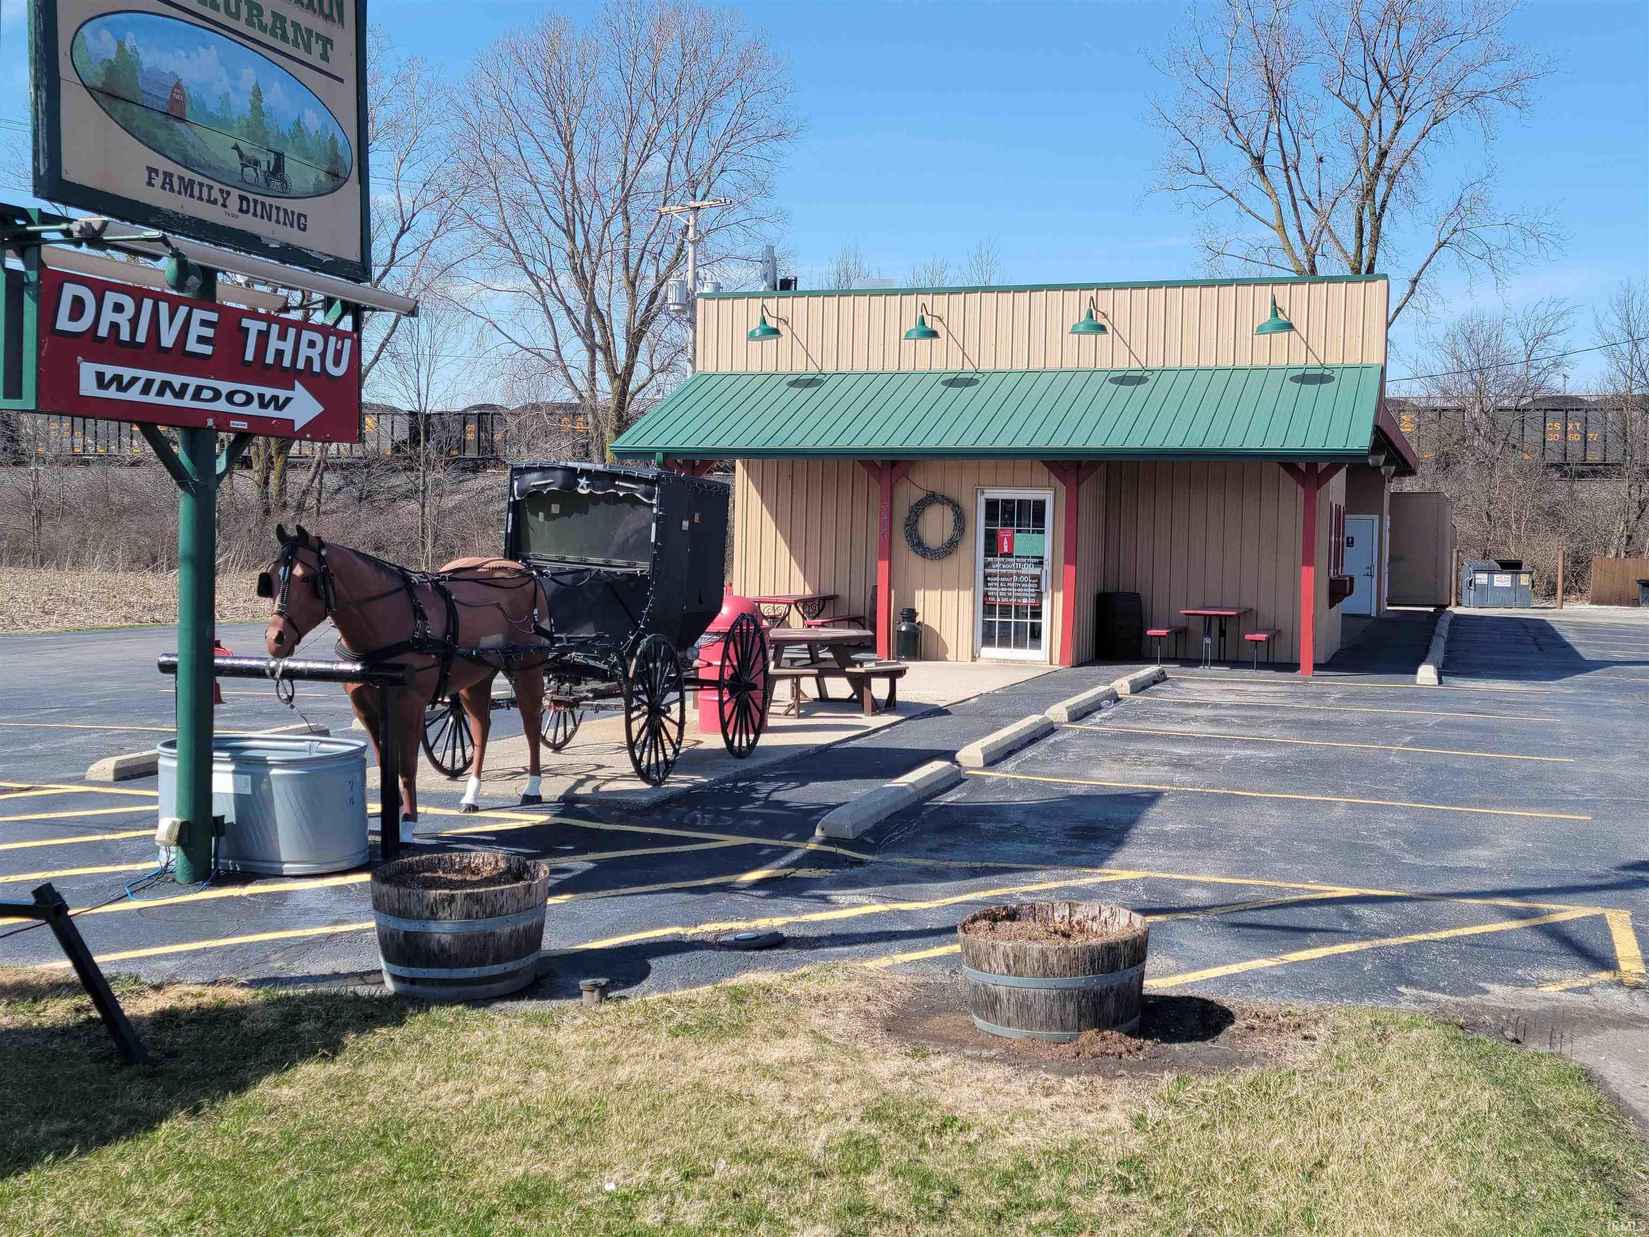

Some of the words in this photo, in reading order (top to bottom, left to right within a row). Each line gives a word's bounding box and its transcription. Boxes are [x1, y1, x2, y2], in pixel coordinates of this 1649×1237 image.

[145, 165, 232, 209] FAMILY
[237, 194, 309, 233] DINING
[55, 282, 219, 356] DRIVE
[240, 317, 352, 378] THRU
[94, 370, 295, 413] WINDOW
